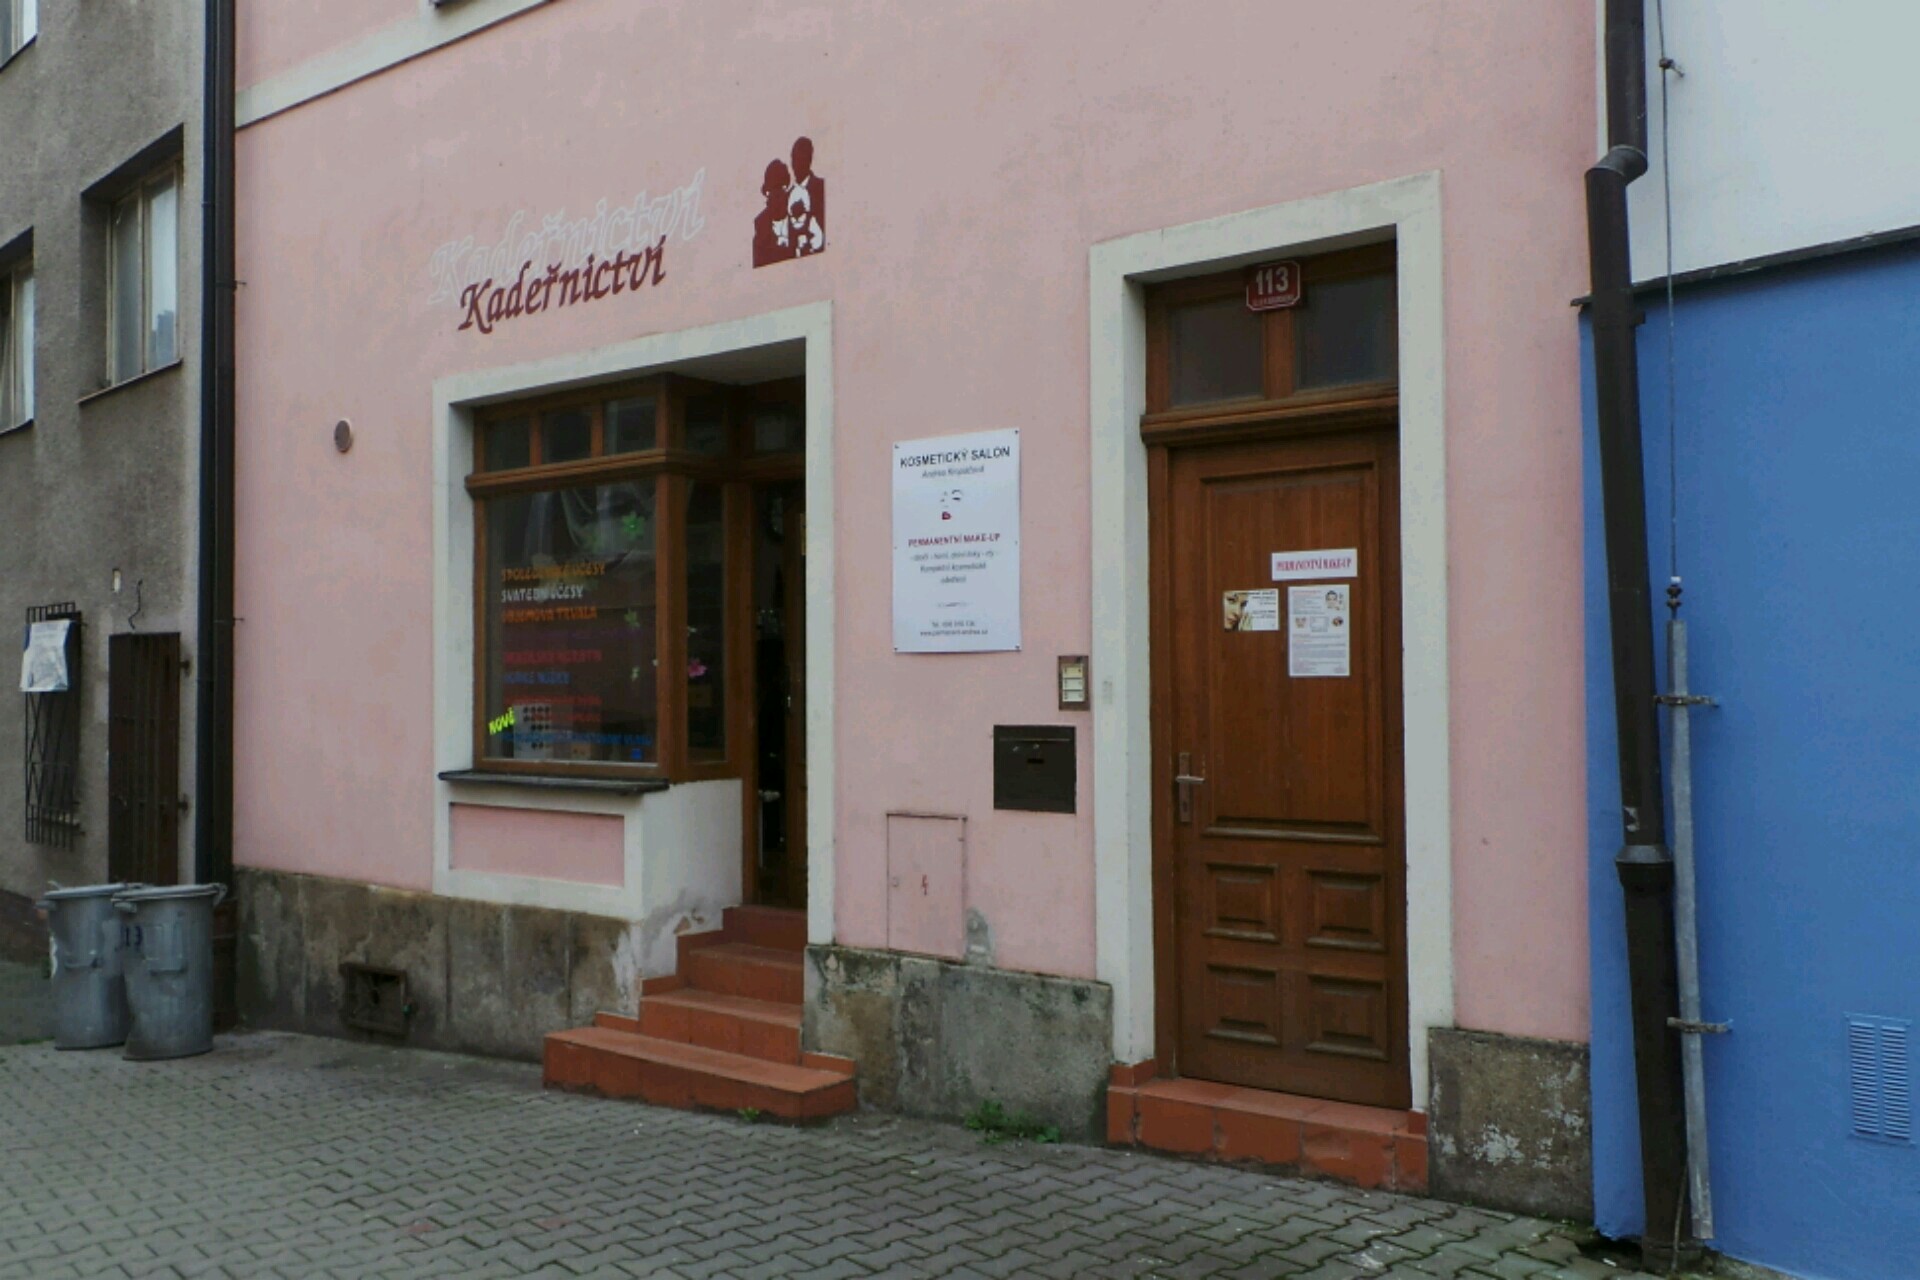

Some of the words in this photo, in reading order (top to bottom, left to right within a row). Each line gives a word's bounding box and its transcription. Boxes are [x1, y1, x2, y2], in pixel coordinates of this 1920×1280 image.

[457, 234, 667, 334] Kadeřnictví
[1256, 266, 1289, 295] 113
[900, 449, 969, 469] KOSMETICKÝ
[971, 446, 1011, 461] SALON
[963, 532, 1001, 544] MAKE-UP
